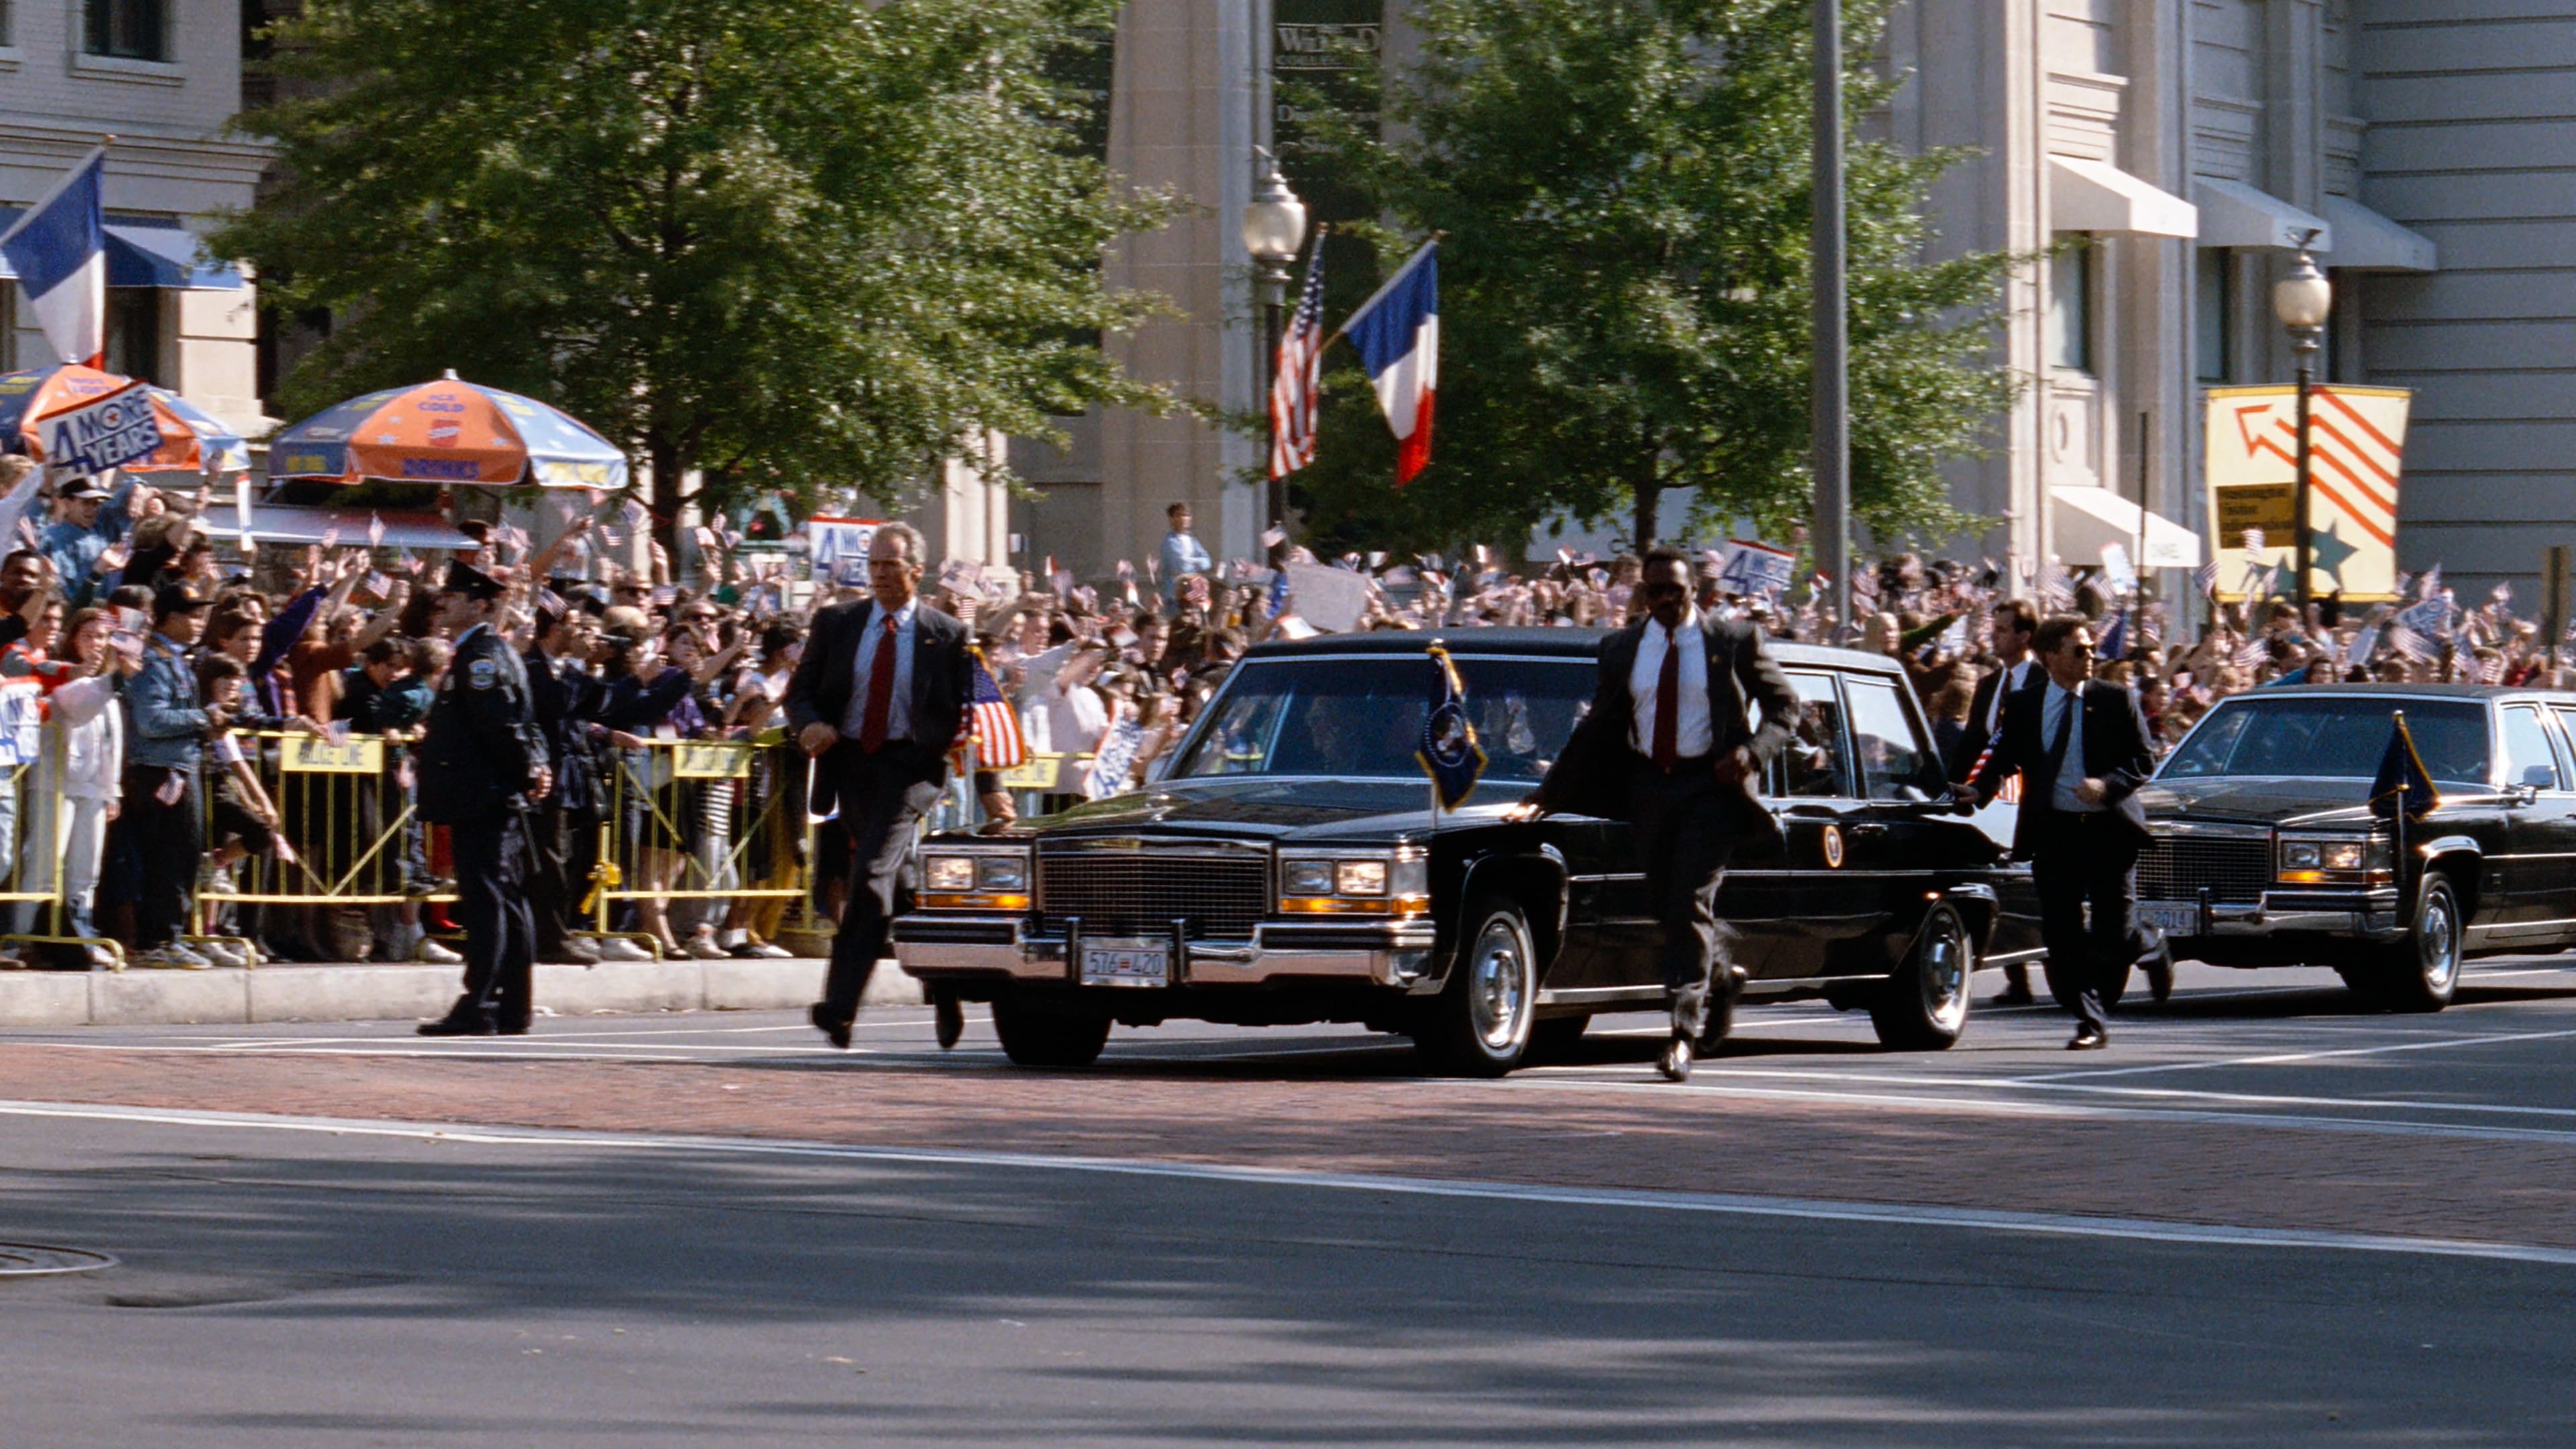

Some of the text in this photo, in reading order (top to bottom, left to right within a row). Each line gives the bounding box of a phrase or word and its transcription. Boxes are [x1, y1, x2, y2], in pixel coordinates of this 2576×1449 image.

[76, 388, 153, 443] MORE
[417, 402, 465, 412] COLD
[52, 419, 99, 477] 4
[85, 421, 162, 469] YEARS
[403, 458, 480, 479] DRINKS
[841, 529, 870, 555] MO
[1722, 549, 1748, 596] 4
